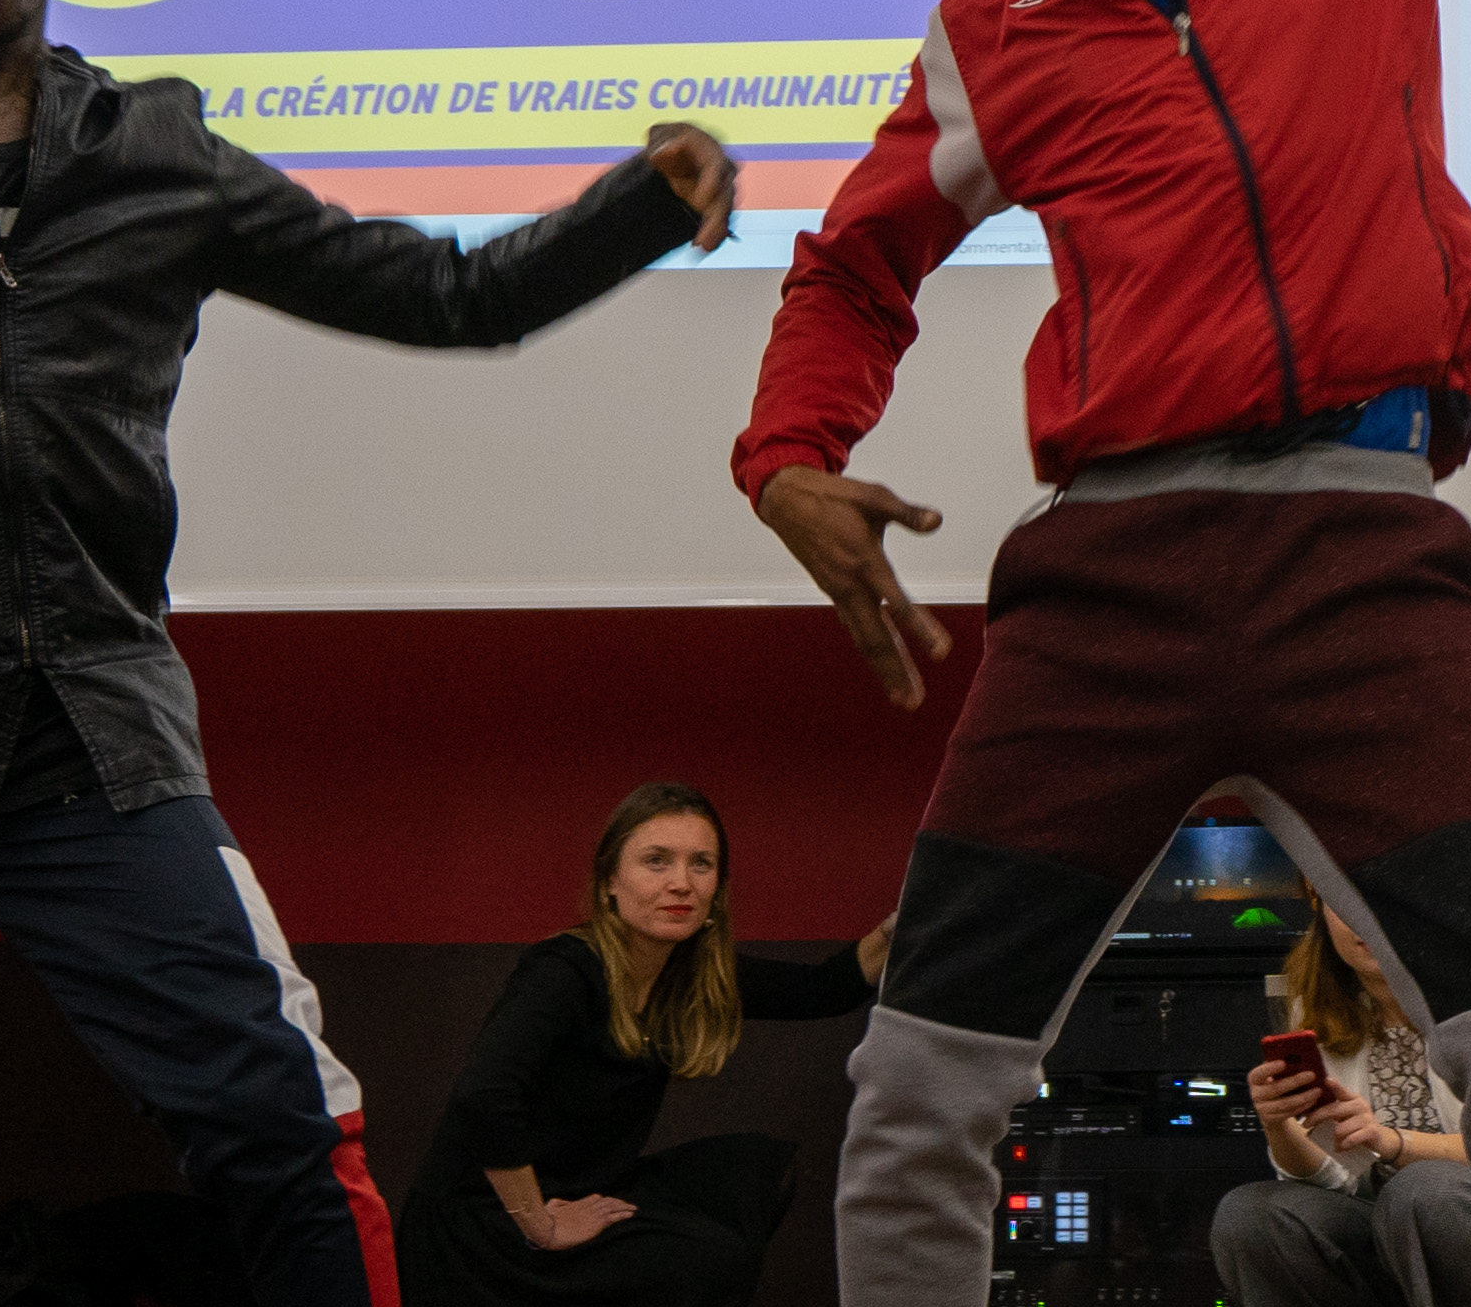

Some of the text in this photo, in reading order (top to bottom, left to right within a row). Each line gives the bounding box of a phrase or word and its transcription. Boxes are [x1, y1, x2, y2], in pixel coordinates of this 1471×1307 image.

[201, 86, 245, 118] LA
[255, 74, 440, 118] CRÉATION
[448, 80, 499, 114] DE
[508, 78, 639, 114] VRAIES
